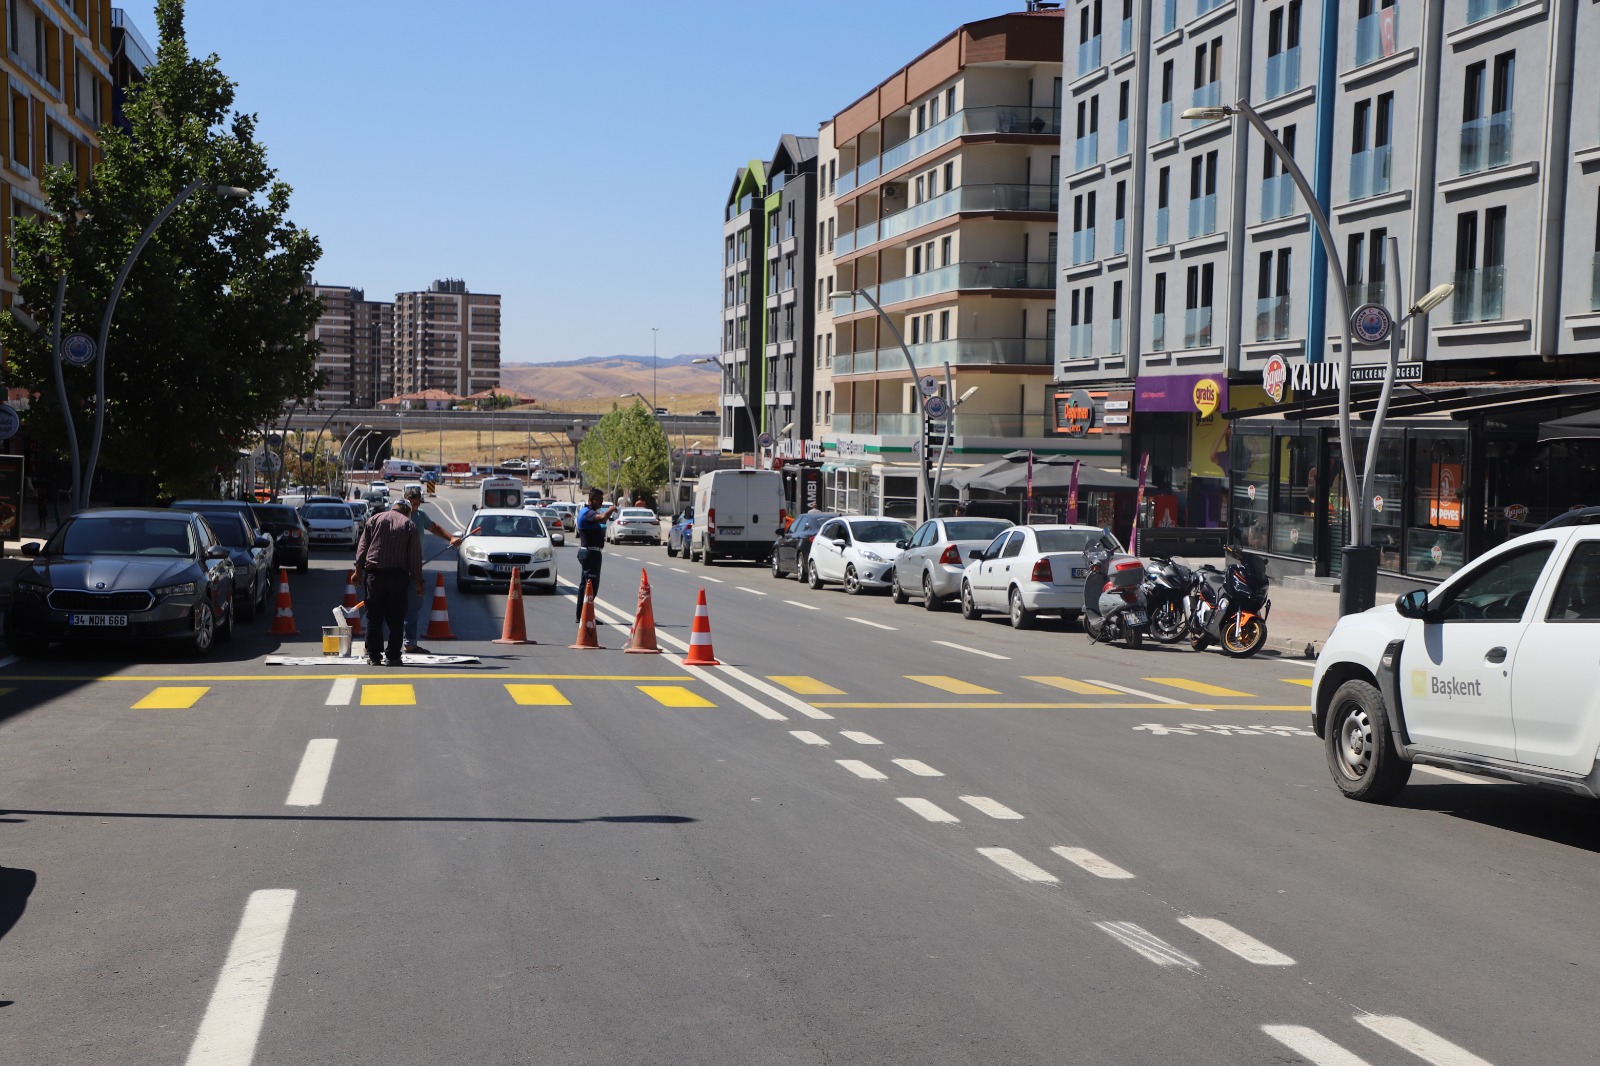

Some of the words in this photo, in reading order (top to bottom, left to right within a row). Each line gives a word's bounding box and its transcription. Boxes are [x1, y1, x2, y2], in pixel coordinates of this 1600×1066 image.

[1291, 362, 1341, 396] KAJUN
[1352, 366, 1420, 380] CHICKENBRGERS
[1196, 384, 1214, 404] gratis
[74, 615, 85, 625] 34
[108, 615, 125, 625] 666
[1431, 676, 1482, 700] Başkent
